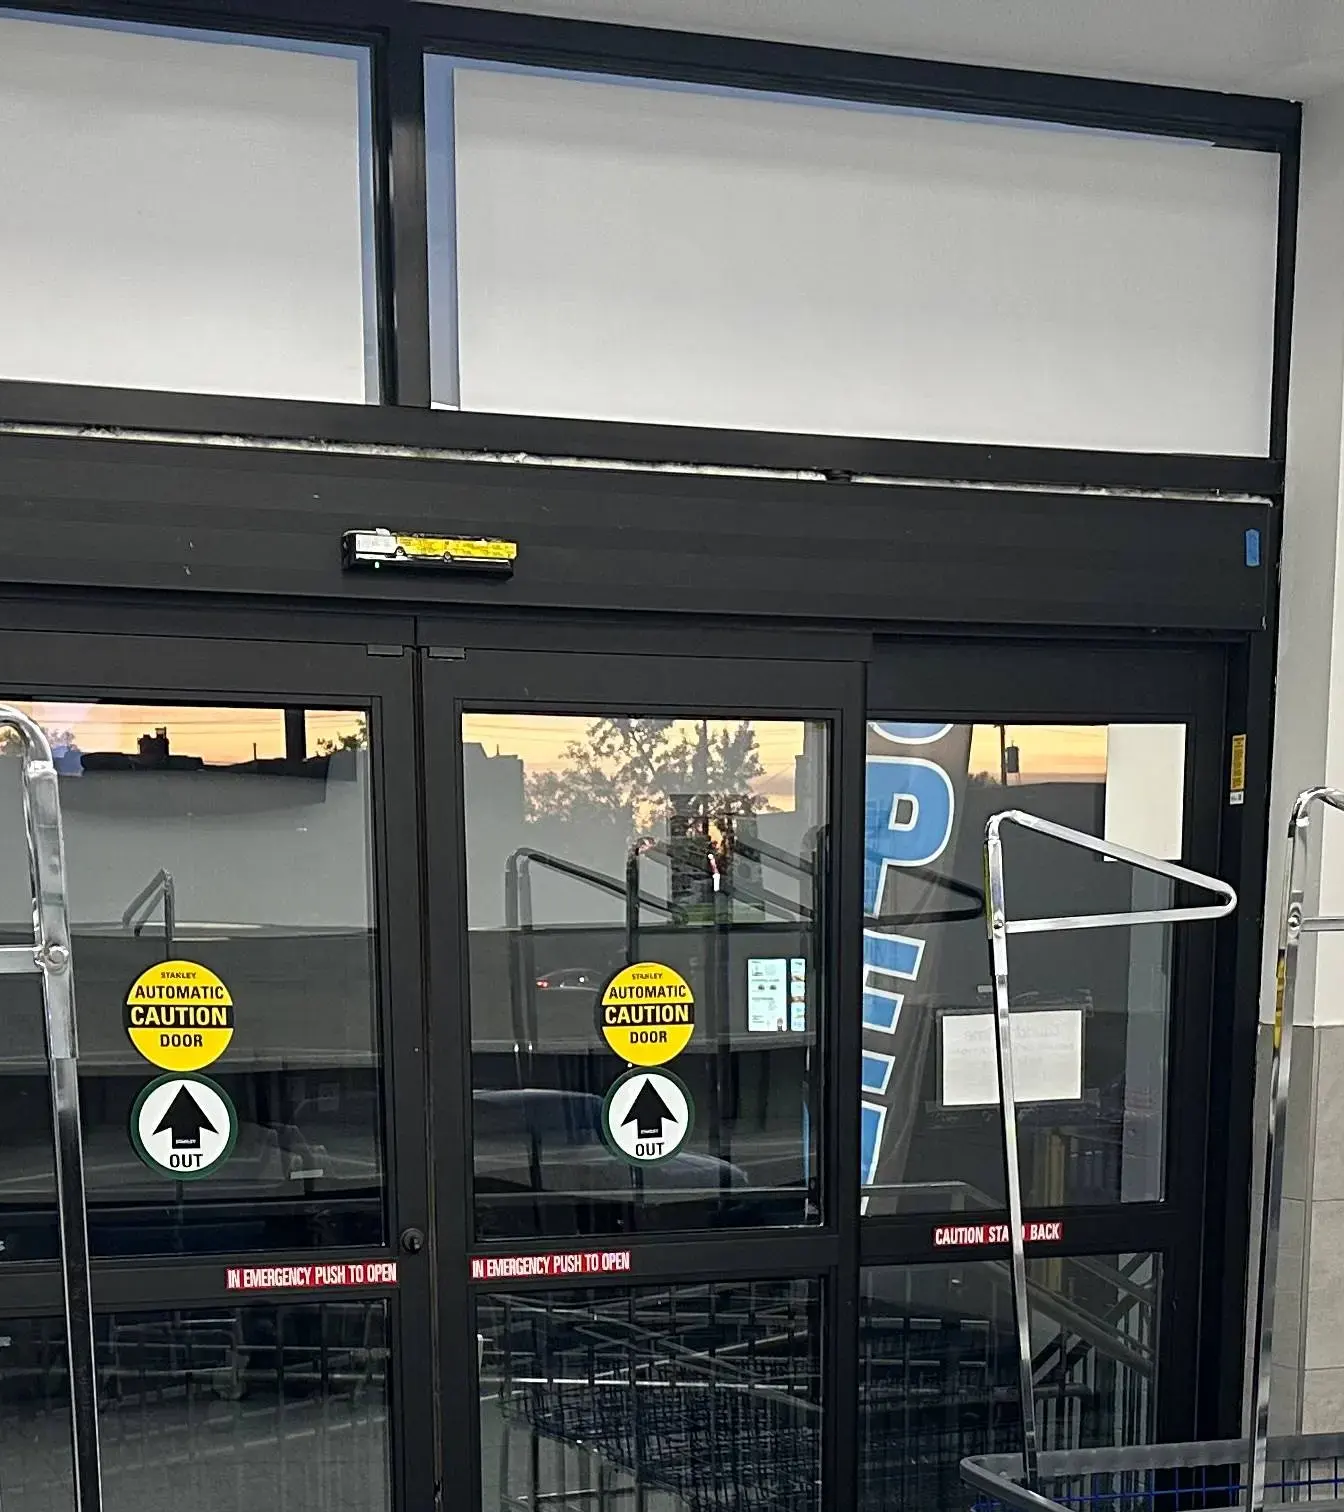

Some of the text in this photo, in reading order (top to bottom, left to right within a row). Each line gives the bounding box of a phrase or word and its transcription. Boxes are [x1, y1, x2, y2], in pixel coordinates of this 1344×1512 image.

[161, 971, 197, 979] STANLEY
[135, 985, 224, 1000] AUTOMATIC
[609, 984, 686, 999] AUTOMATIC
[131, 1006, 227, 1026] CAUTION
[606, 1004, 689, 1024] CAUTION
[160, 1034, 203, 1047] DOOR
[630, 1030, 667, 1043] DOOR
[636, 1143, 664, 1156] OUT
[169, 1154, 203, 1168] OUT
[935, 1226, 983, 1245] CAUTION
[1030, 1222, 1061, 1241] BACK
[472, 1251, 630, 1278] IN EMERGENCY PUSH TO OPEN
[227, 1262, 397, 1288] IN EMERGENCY PUSH TO OPEN
